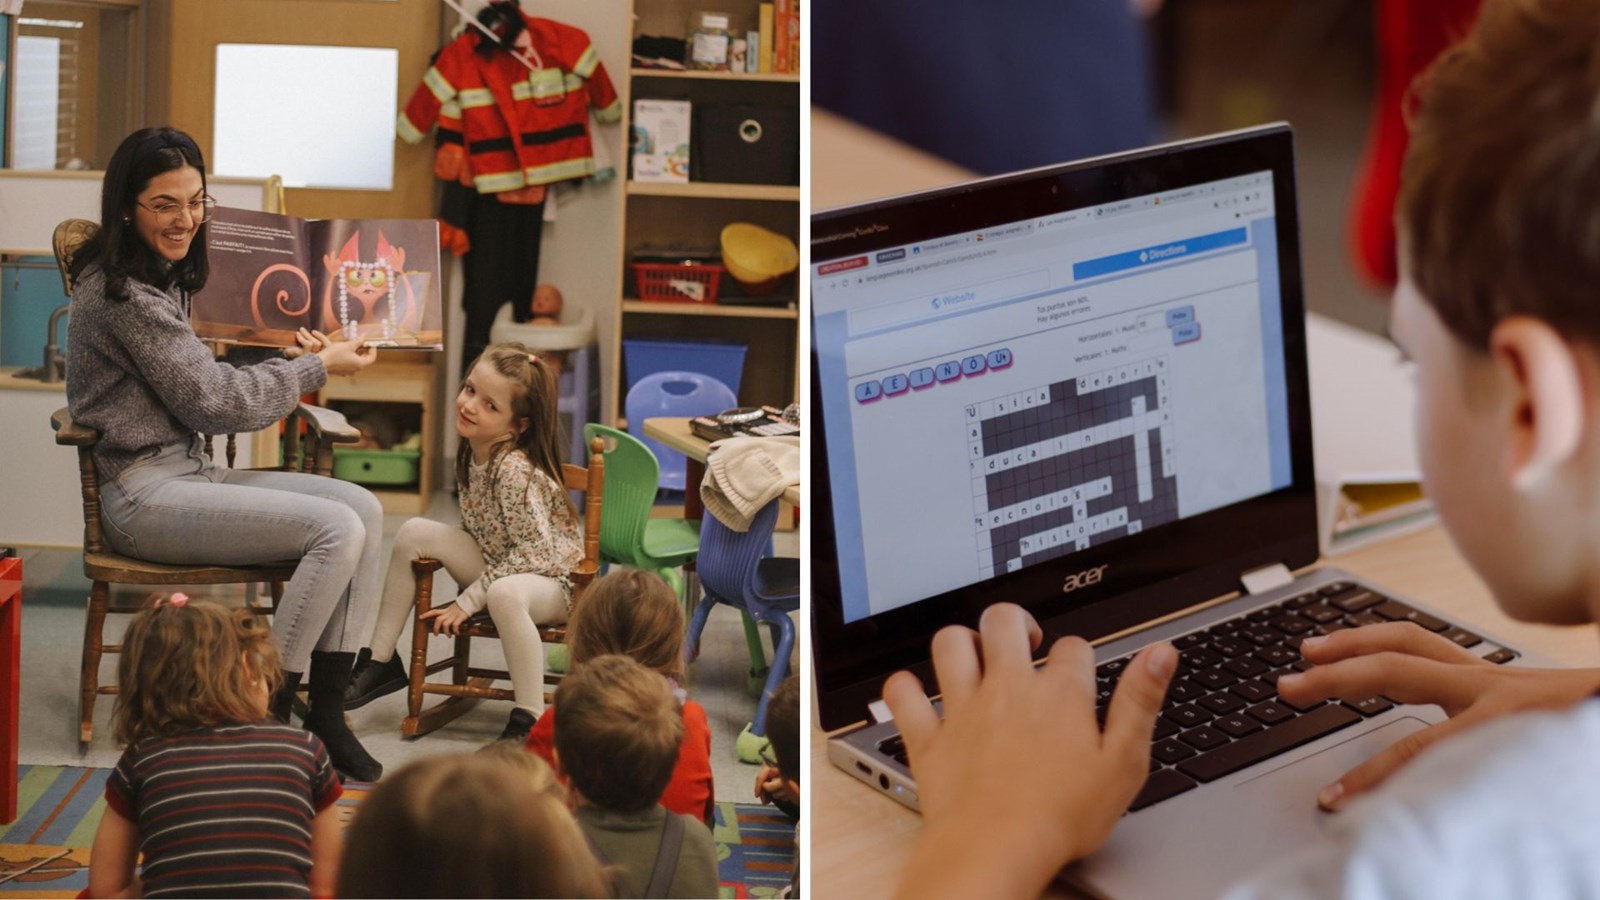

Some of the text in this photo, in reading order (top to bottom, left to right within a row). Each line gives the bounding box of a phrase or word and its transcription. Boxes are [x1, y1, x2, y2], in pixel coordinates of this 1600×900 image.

[1149, 244, 1187, 260] Directions
[942, 292, 975, 305] Website
[1062, 563, 1109, 593] acer
